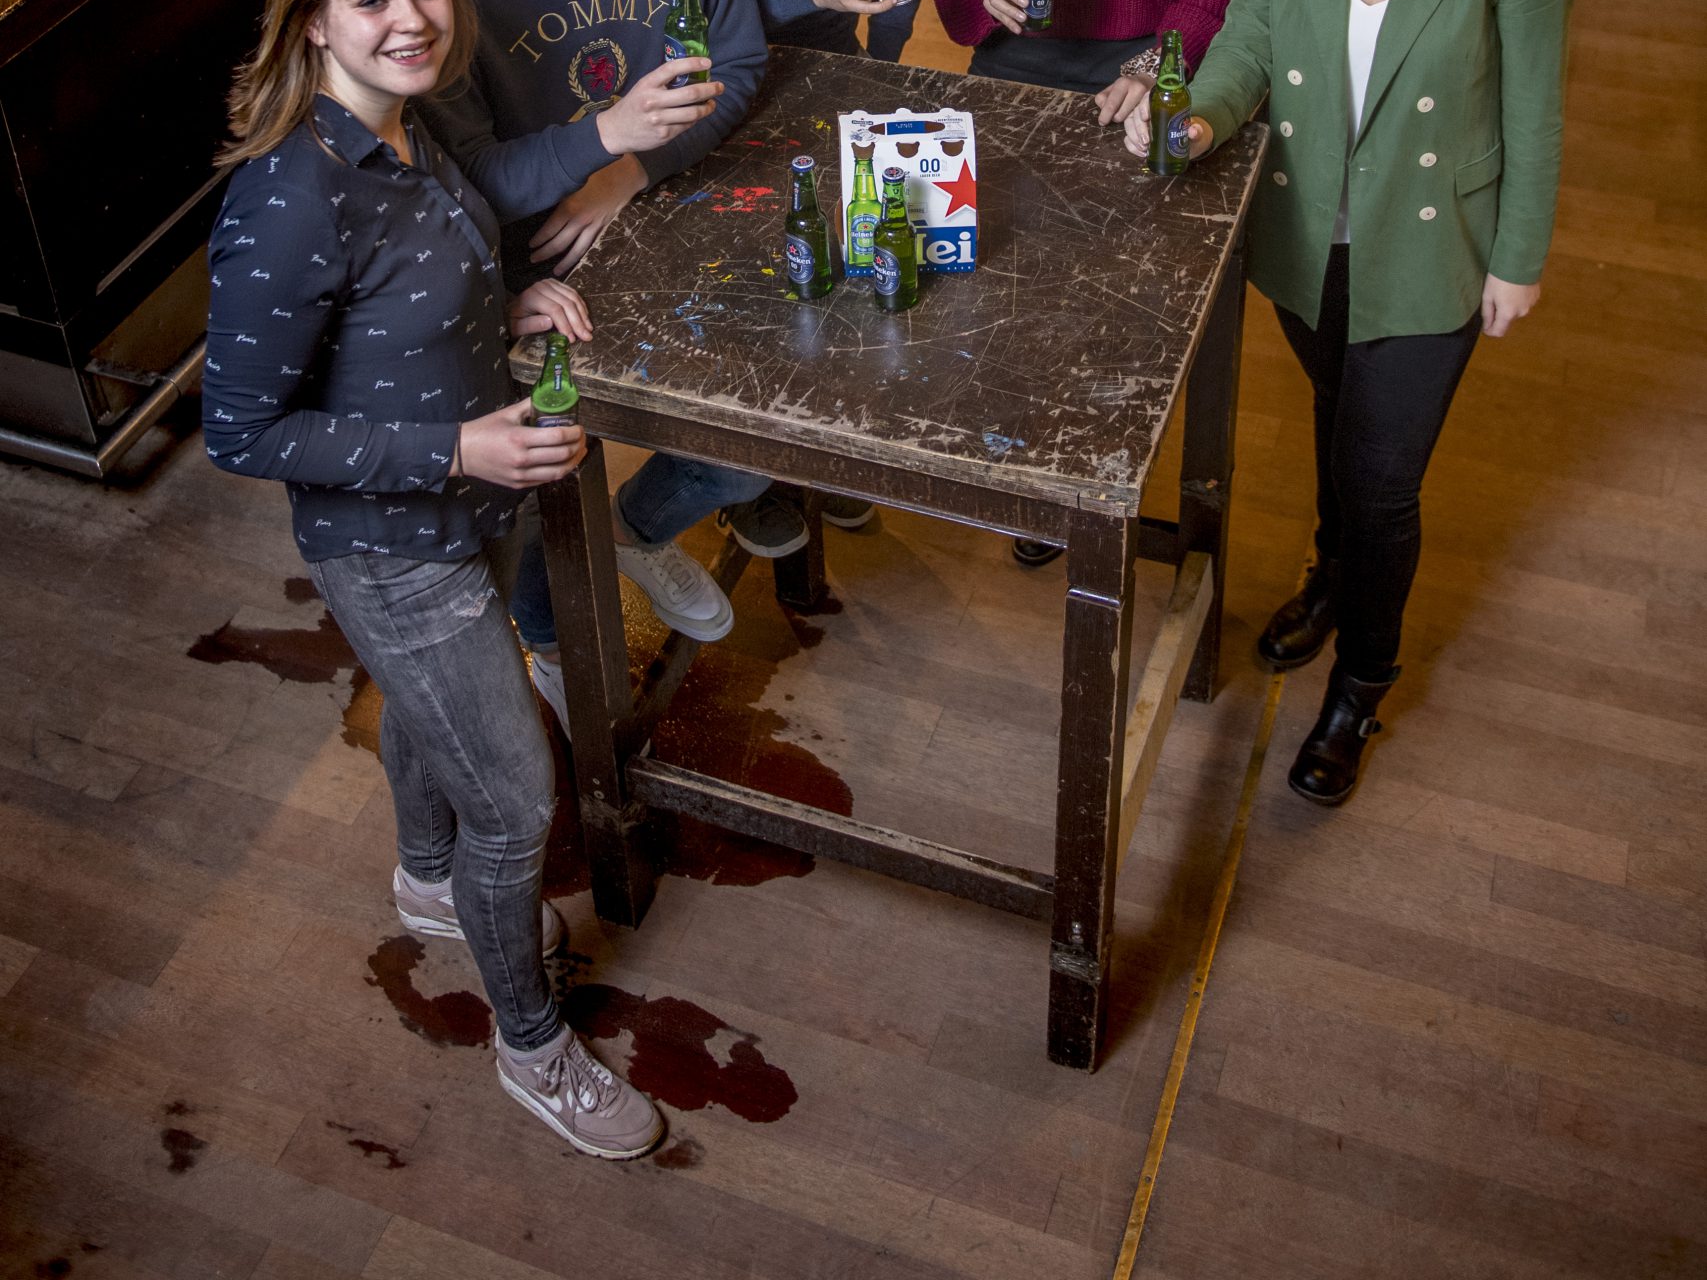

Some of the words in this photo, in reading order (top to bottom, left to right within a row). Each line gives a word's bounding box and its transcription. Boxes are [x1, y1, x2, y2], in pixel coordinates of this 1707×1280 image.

[920, 158, 940, 173] 0.0
[250, 269, 270, 280] Paris
[368, 328, 387, 336] Paris
[281, 365, 302, 375] Paris
[375, 380, 394, 389] Paris
[420, 389, 442, 401] Paris
[346, 447, 363, 466] Paris
[385, 506, 407, 515] Paris
[417, 527, 436, 535] Paris
